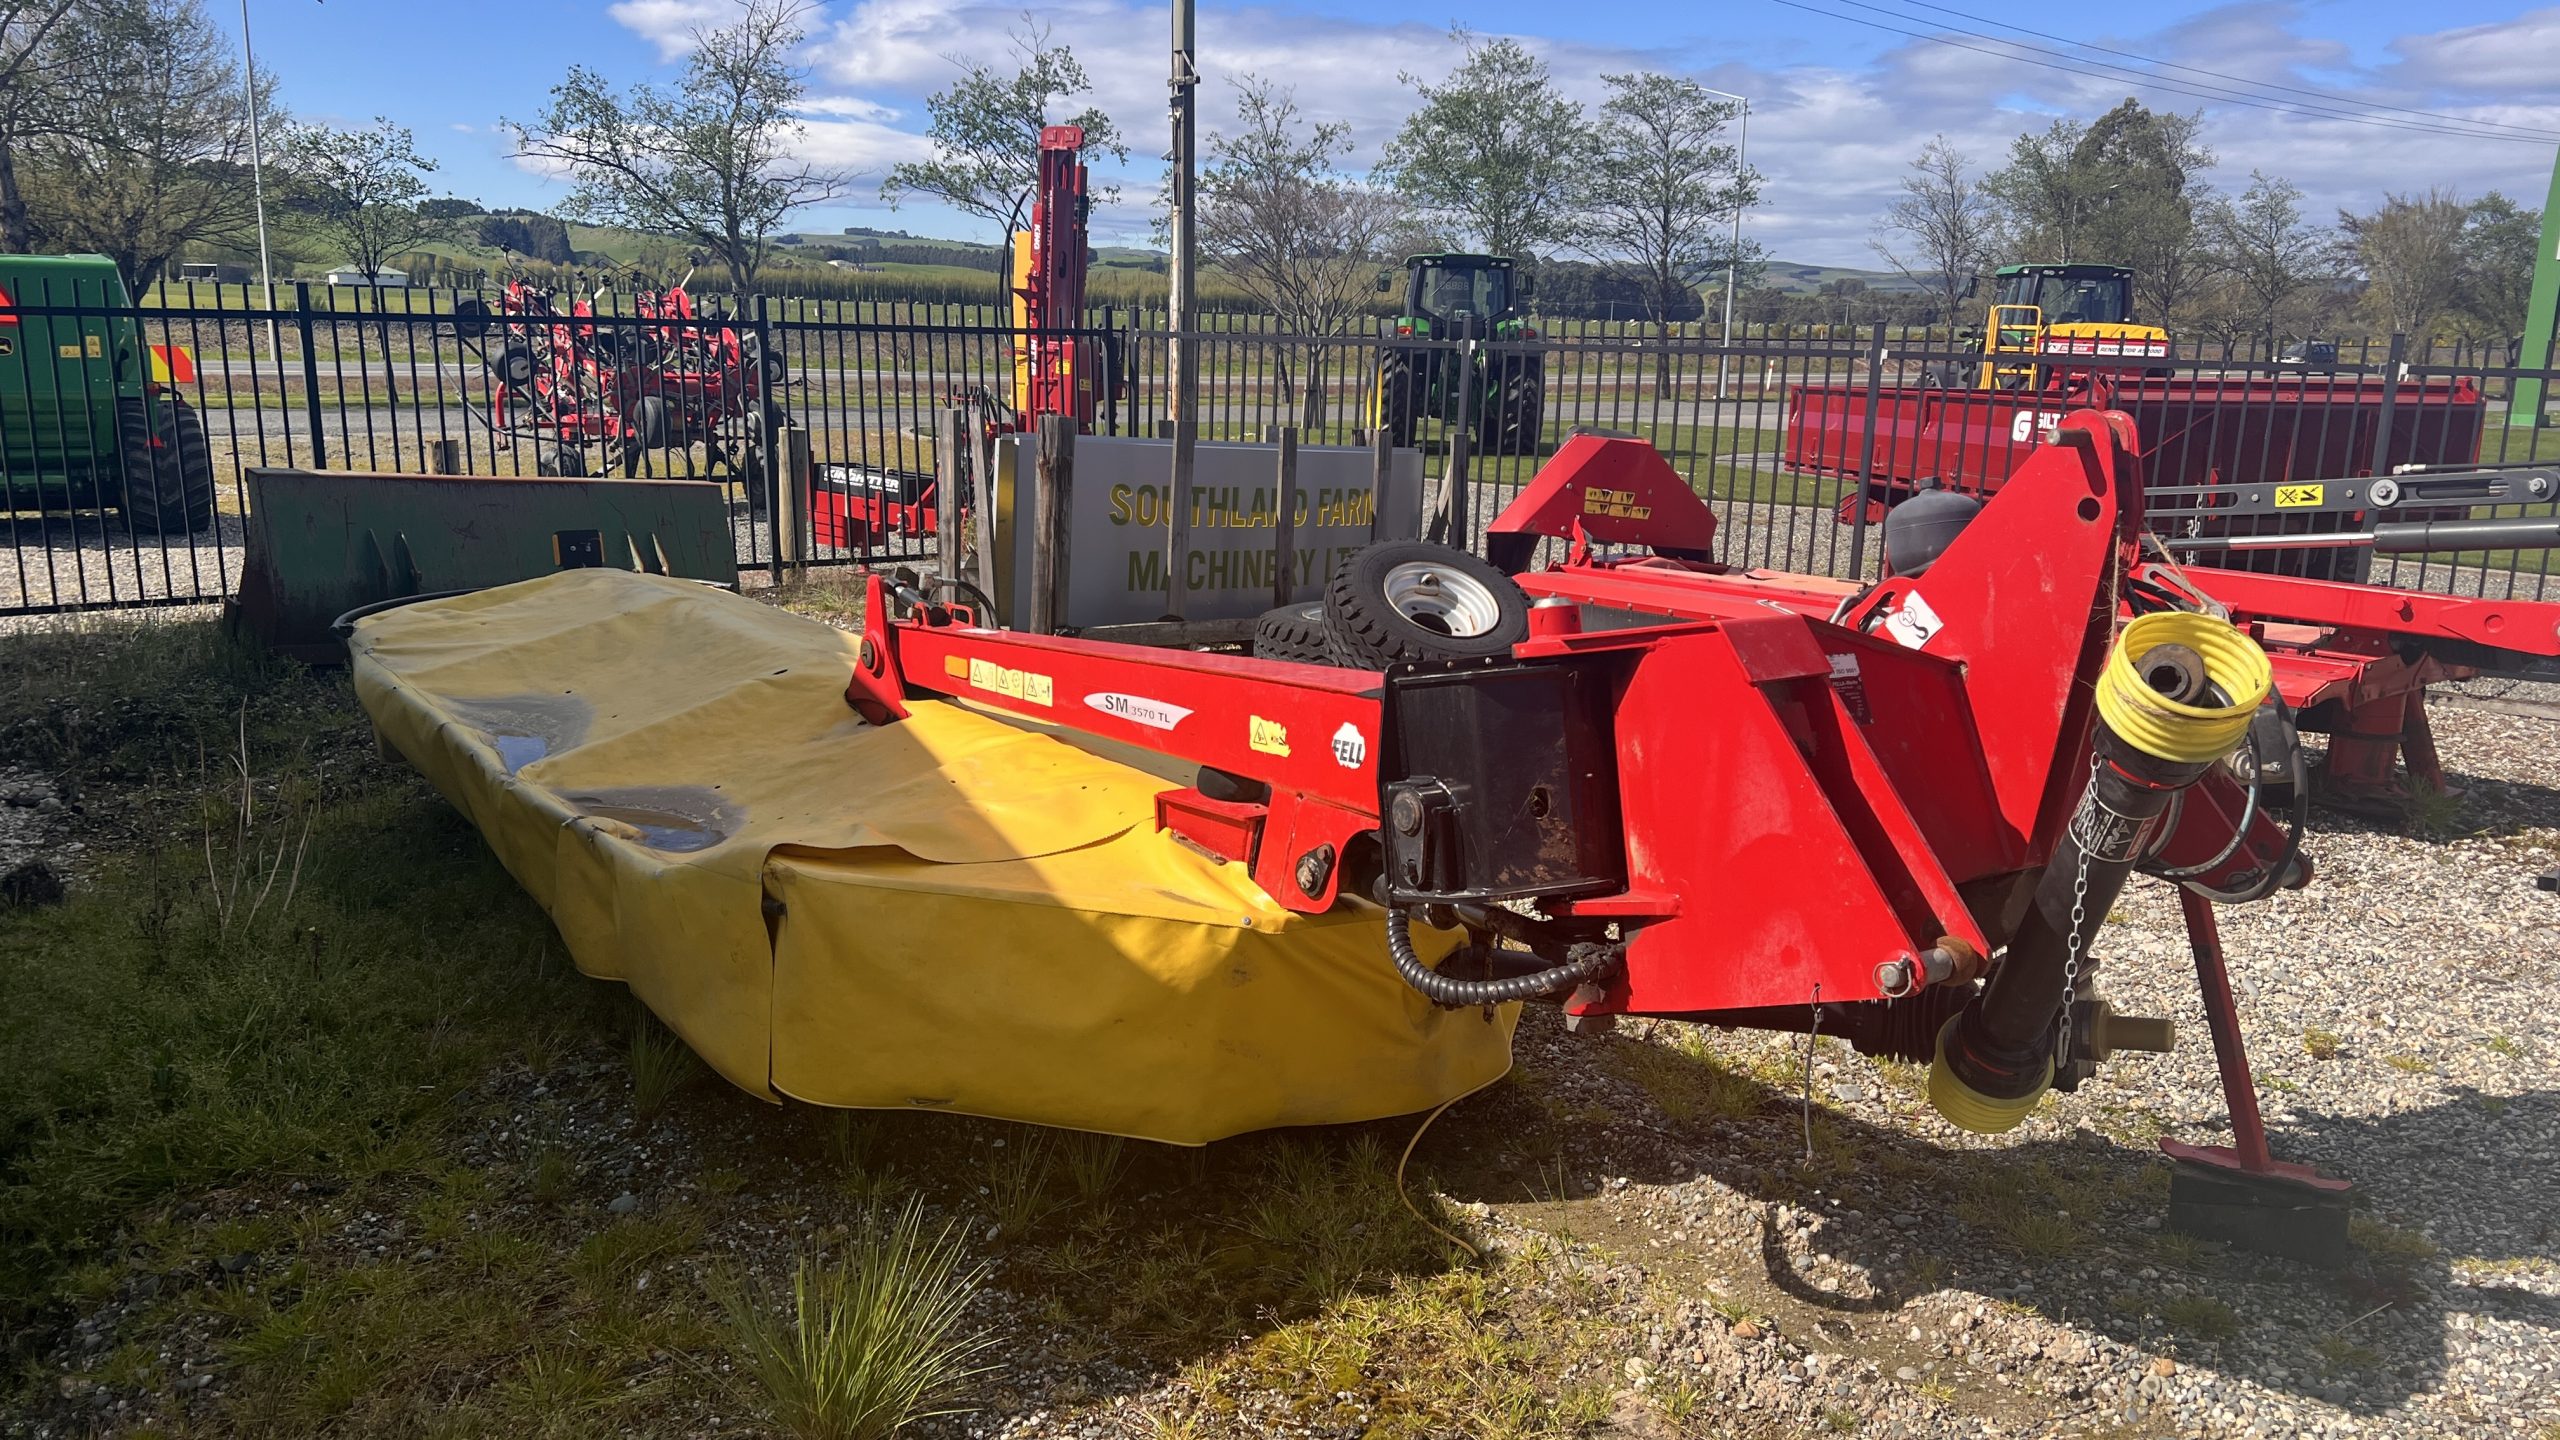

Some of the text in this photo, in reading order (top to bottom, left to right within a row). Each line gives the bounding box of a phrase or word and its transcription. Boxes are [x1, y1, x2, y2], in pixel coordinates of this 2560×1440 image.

[1128, 546, 1365, 592] MCHINEY LT
[1105, 695, 1170, 723] SM 3570 TL
